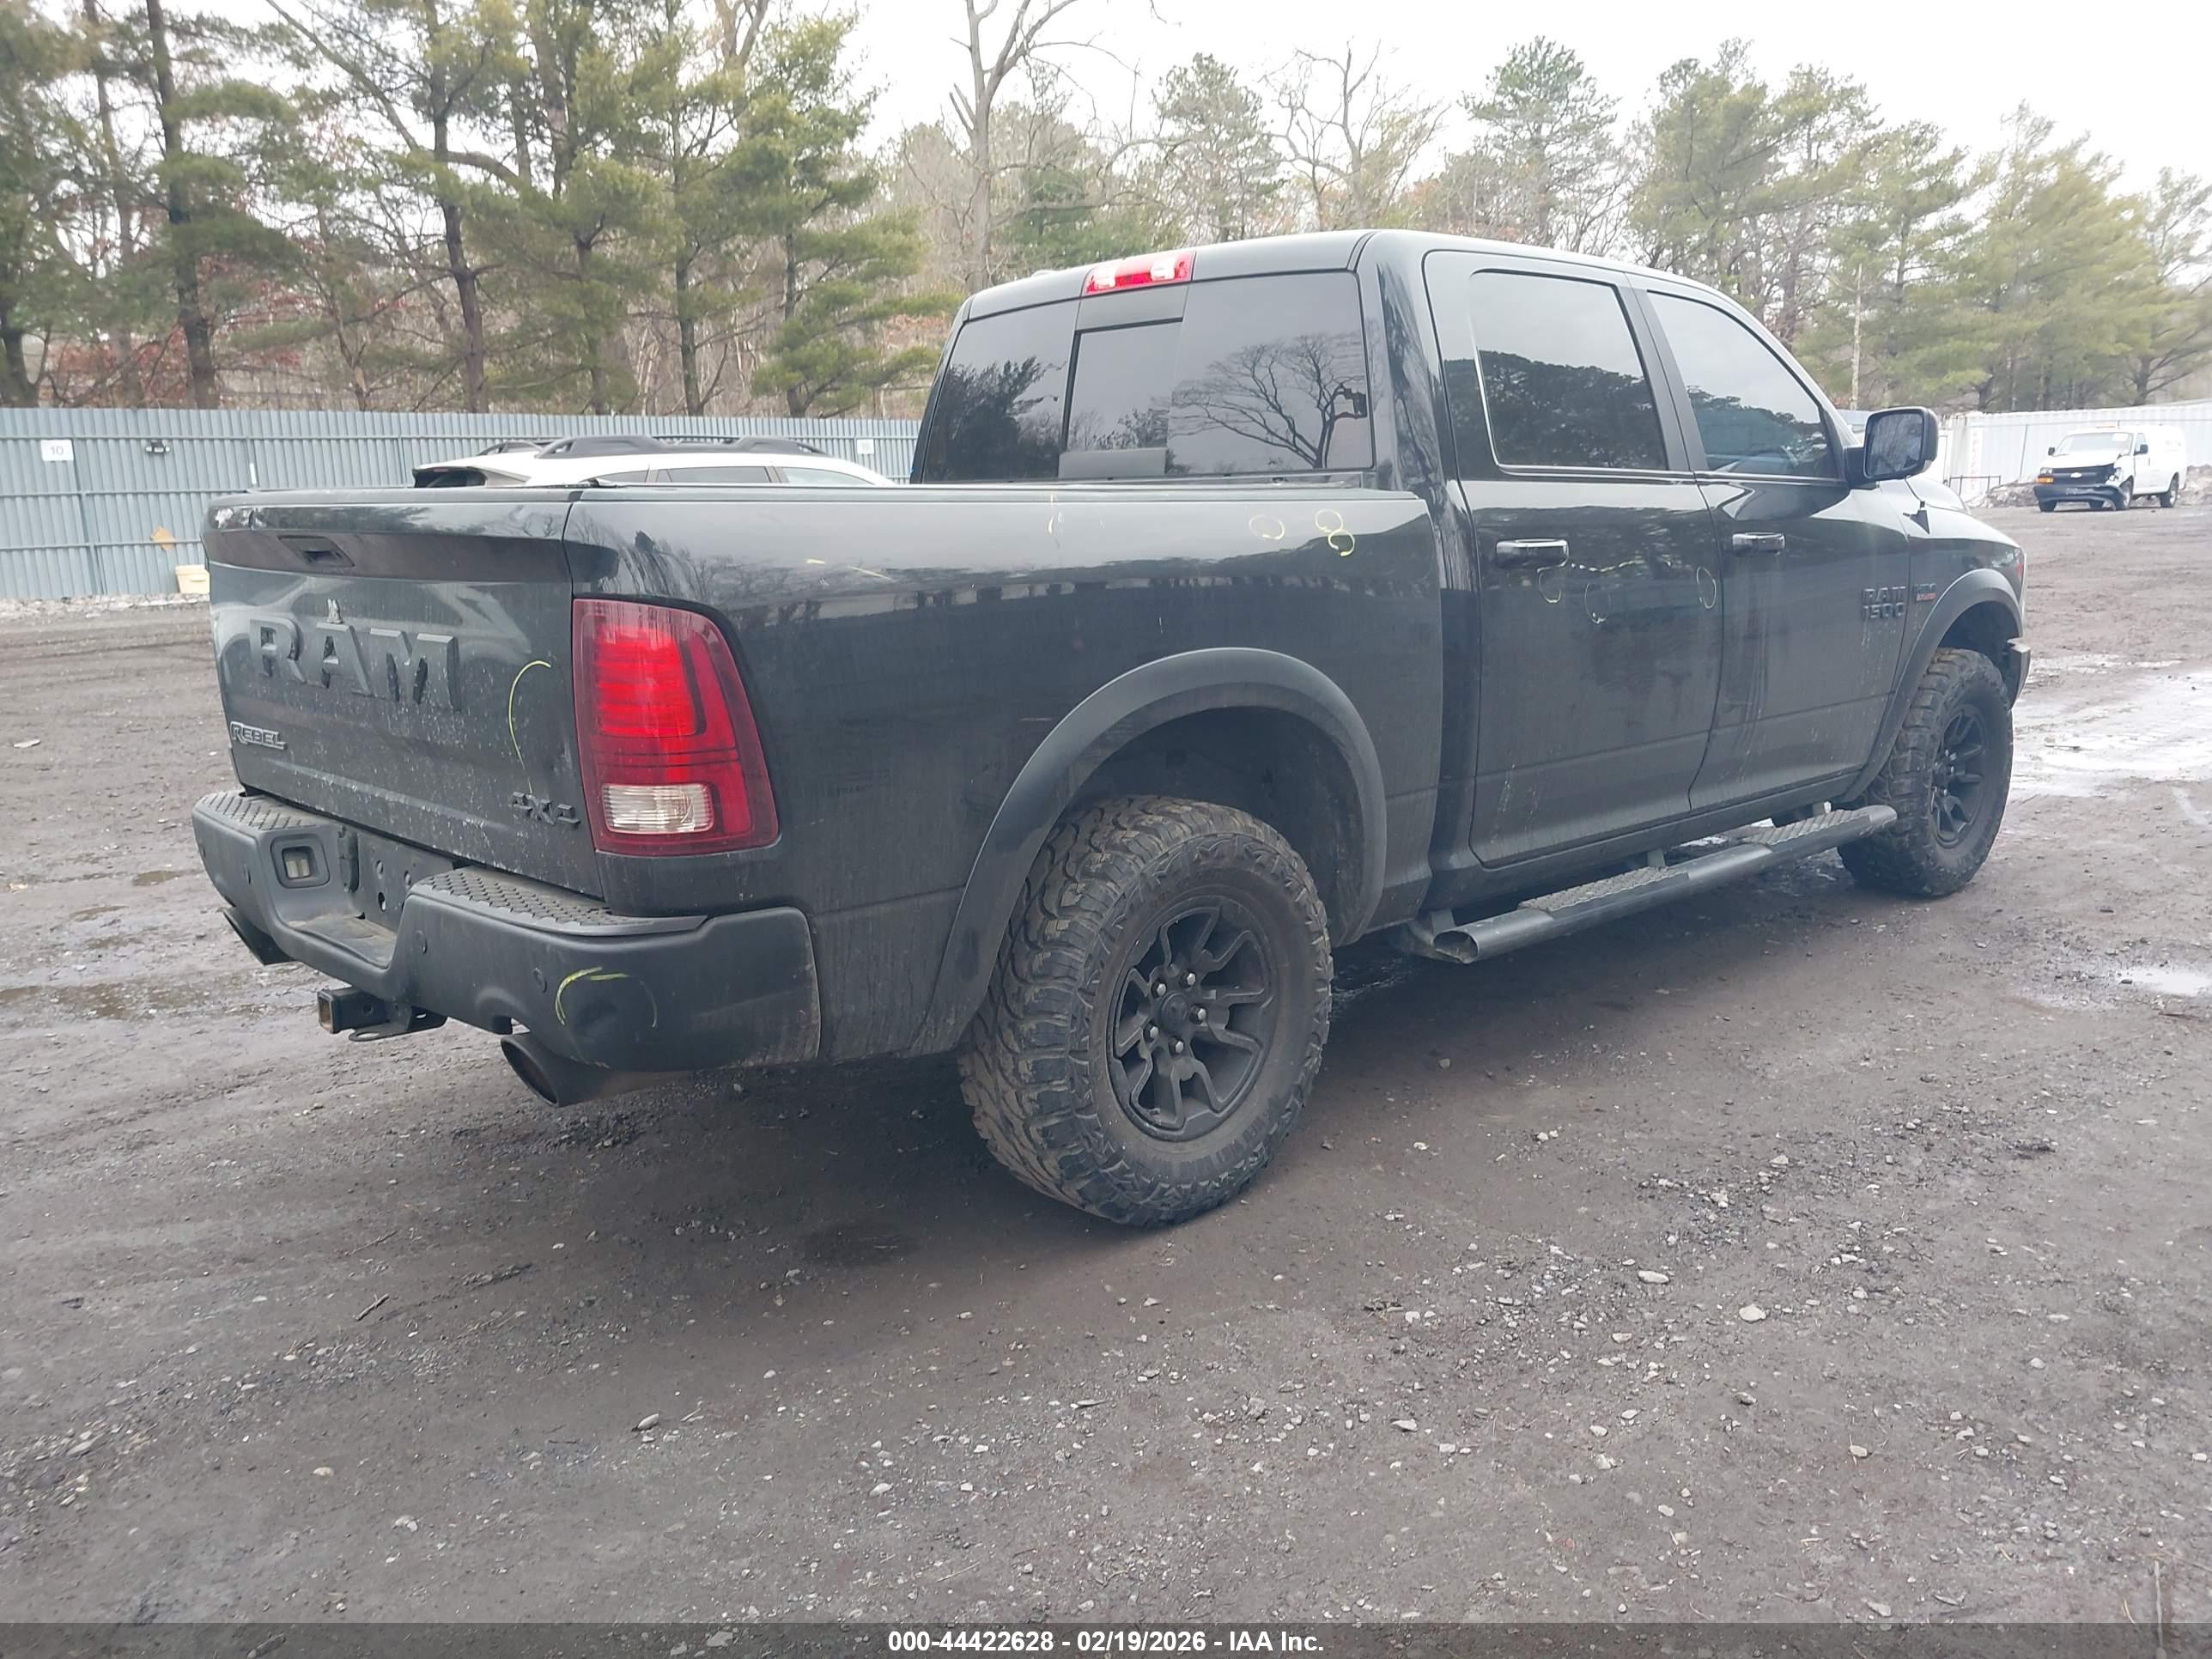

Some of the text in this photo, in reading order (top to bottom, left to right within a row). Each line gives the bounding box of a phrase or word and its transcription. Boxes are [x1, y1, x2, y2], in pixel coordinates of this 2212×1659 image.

[50, 446, 64, 455] 10
[1862, 602, 1905, 619] 1500
[249, 617, 461, 711] RAM
[230, 721, 287, 750] REBEL
